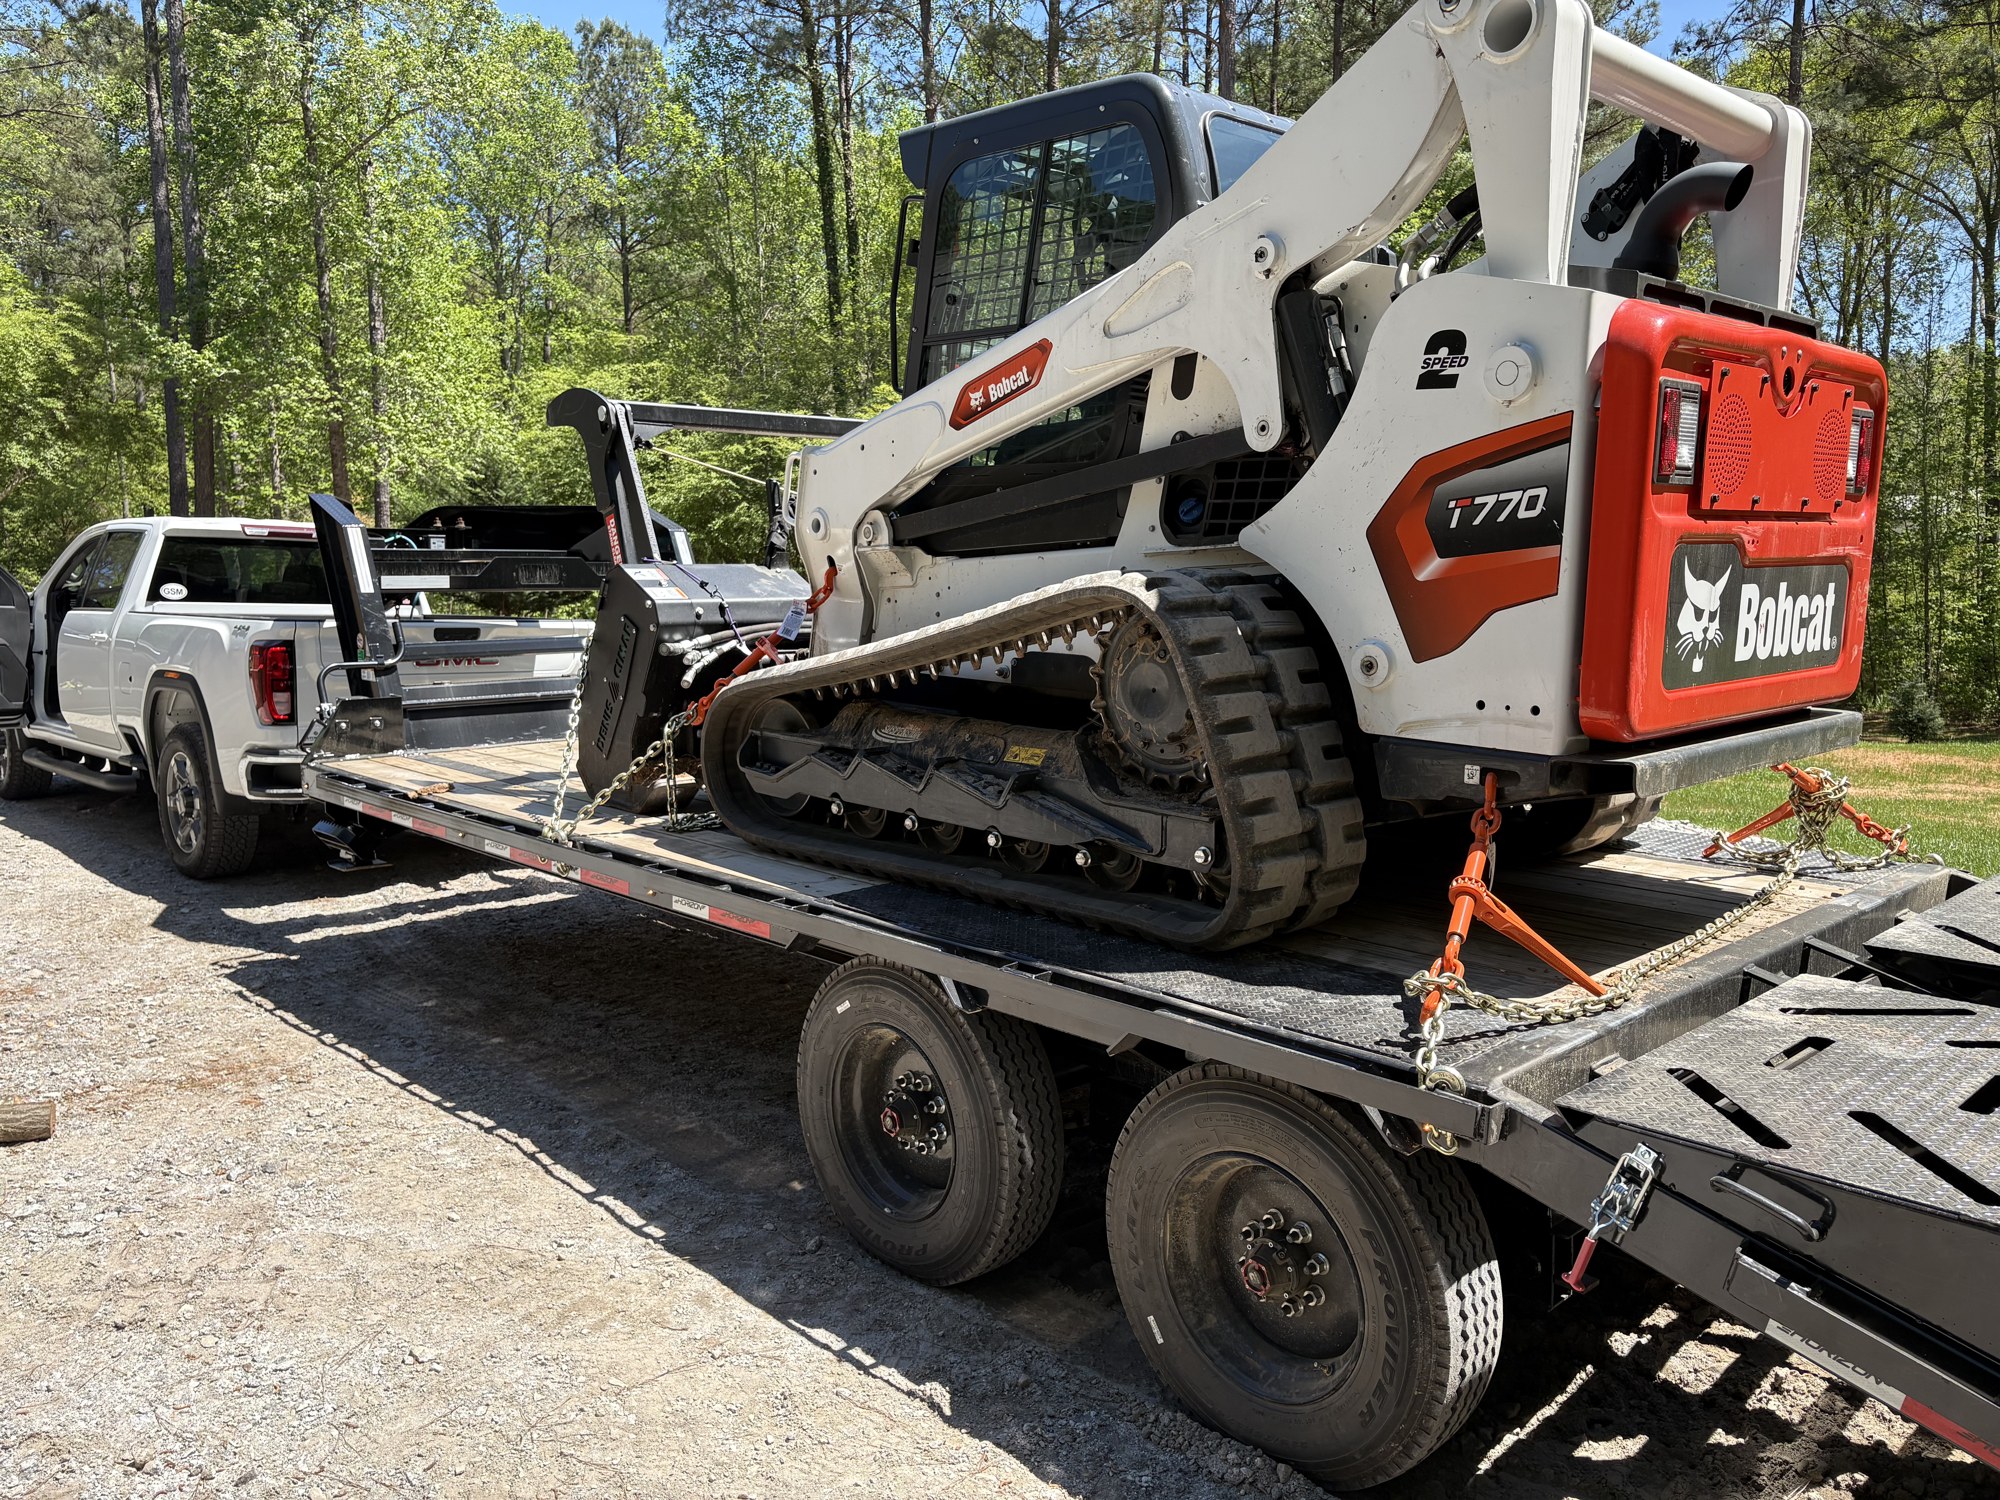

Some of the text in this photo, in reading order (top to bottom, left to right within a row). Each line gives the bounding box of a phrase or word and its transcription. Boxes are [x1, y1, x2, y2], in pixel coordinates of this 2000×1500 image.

[1415, 328, 1470, 391] 2 SPEED
[987, 365, 1032, 403] Bobcat
[1447, 485, 1549, 530] T770
[163, 587, 184, 596] GSM
[1734, 581, 1837, 662] Bobcat
[674, 897, 705, 911] HORIZON
[1358, 1227, 1401, 1429] PROVIDER
